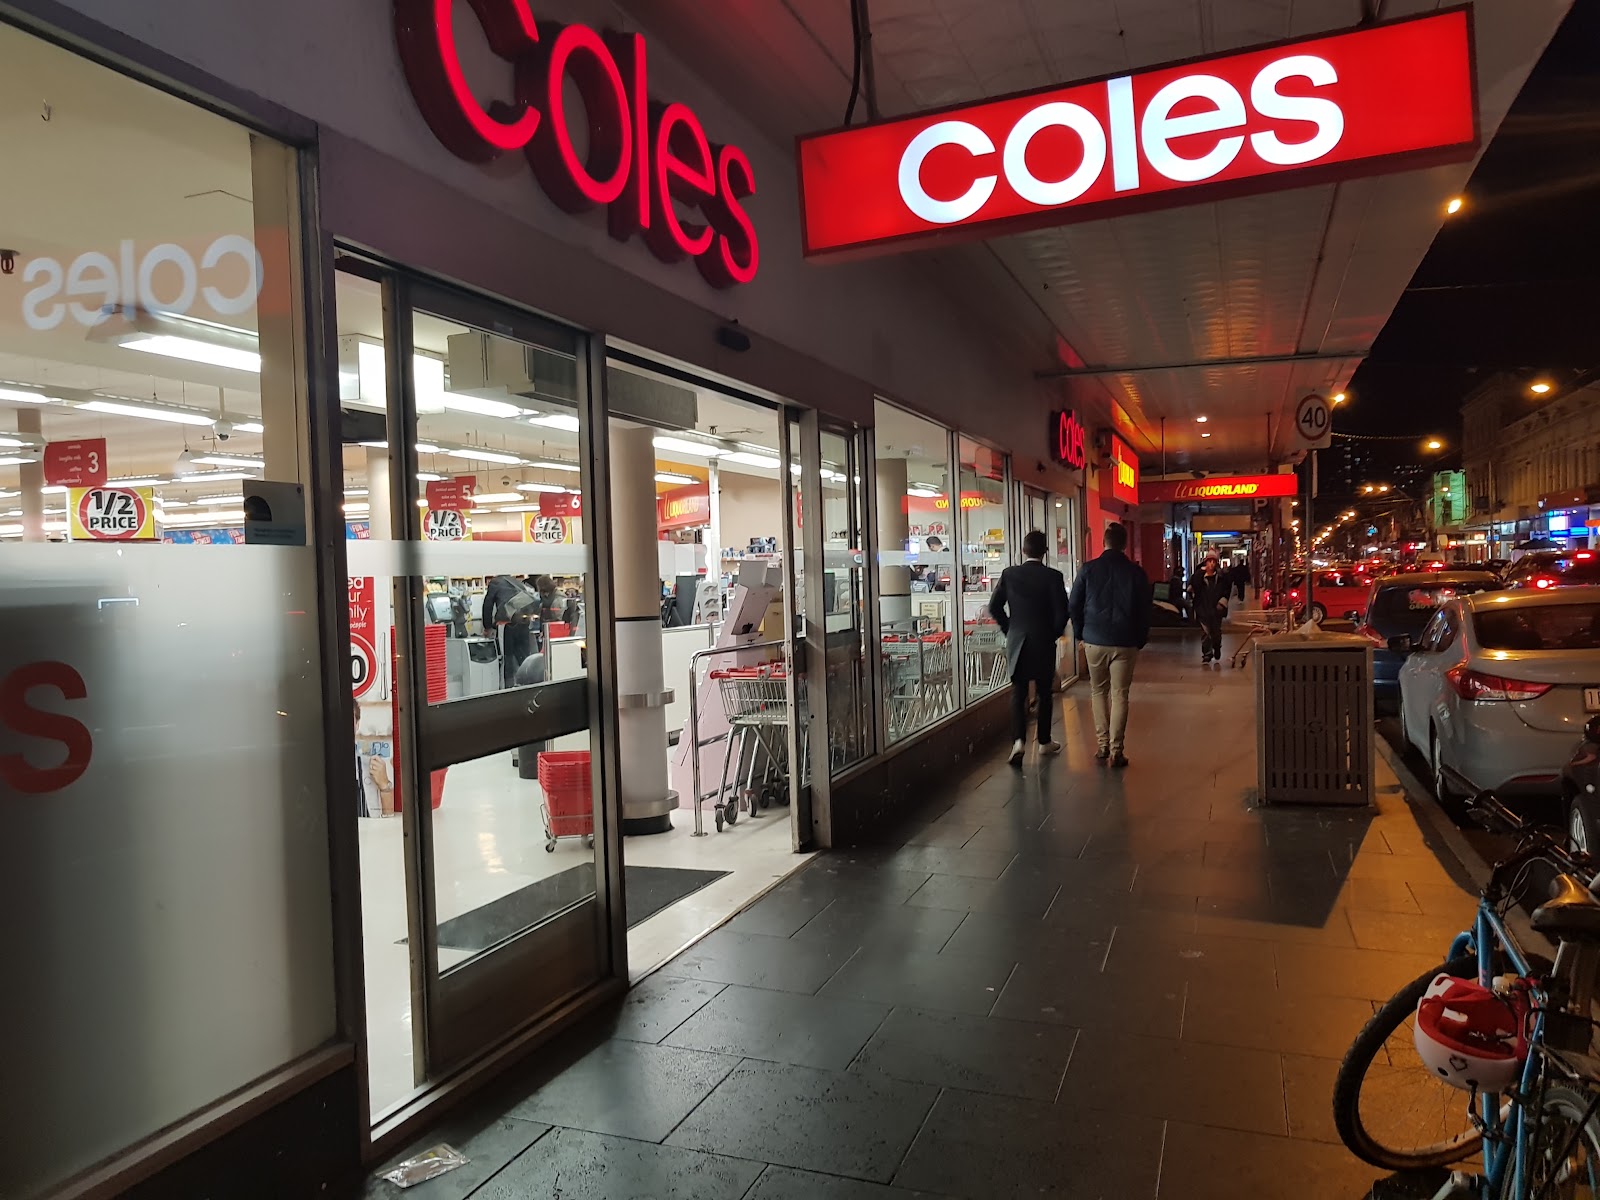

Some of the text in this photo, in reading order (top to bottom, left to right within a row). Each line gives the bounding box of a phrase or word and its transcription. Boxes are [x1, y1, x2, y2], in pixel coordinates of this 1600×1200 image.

[431, 0, 760, 285] coles
[897, 54, 1344, 224] coles
[1301, 406, 1326, 428] 40
[1059, 409, 1085, 471] coles
[87, 451, 100, 474] 3
[461, 485, 471, 500] 5
[1188, 483, 1257, 498] LIQUORLAND
[90, 490, 134, 516] 1/2
[571, 495, 581, 509] 6
[89, 516, 138, 530] PRICE
[430, 510, 459, 527] 1/2
[429, 527, 462, 537] PRICE
[535, 531, 562, 540] PRICE
